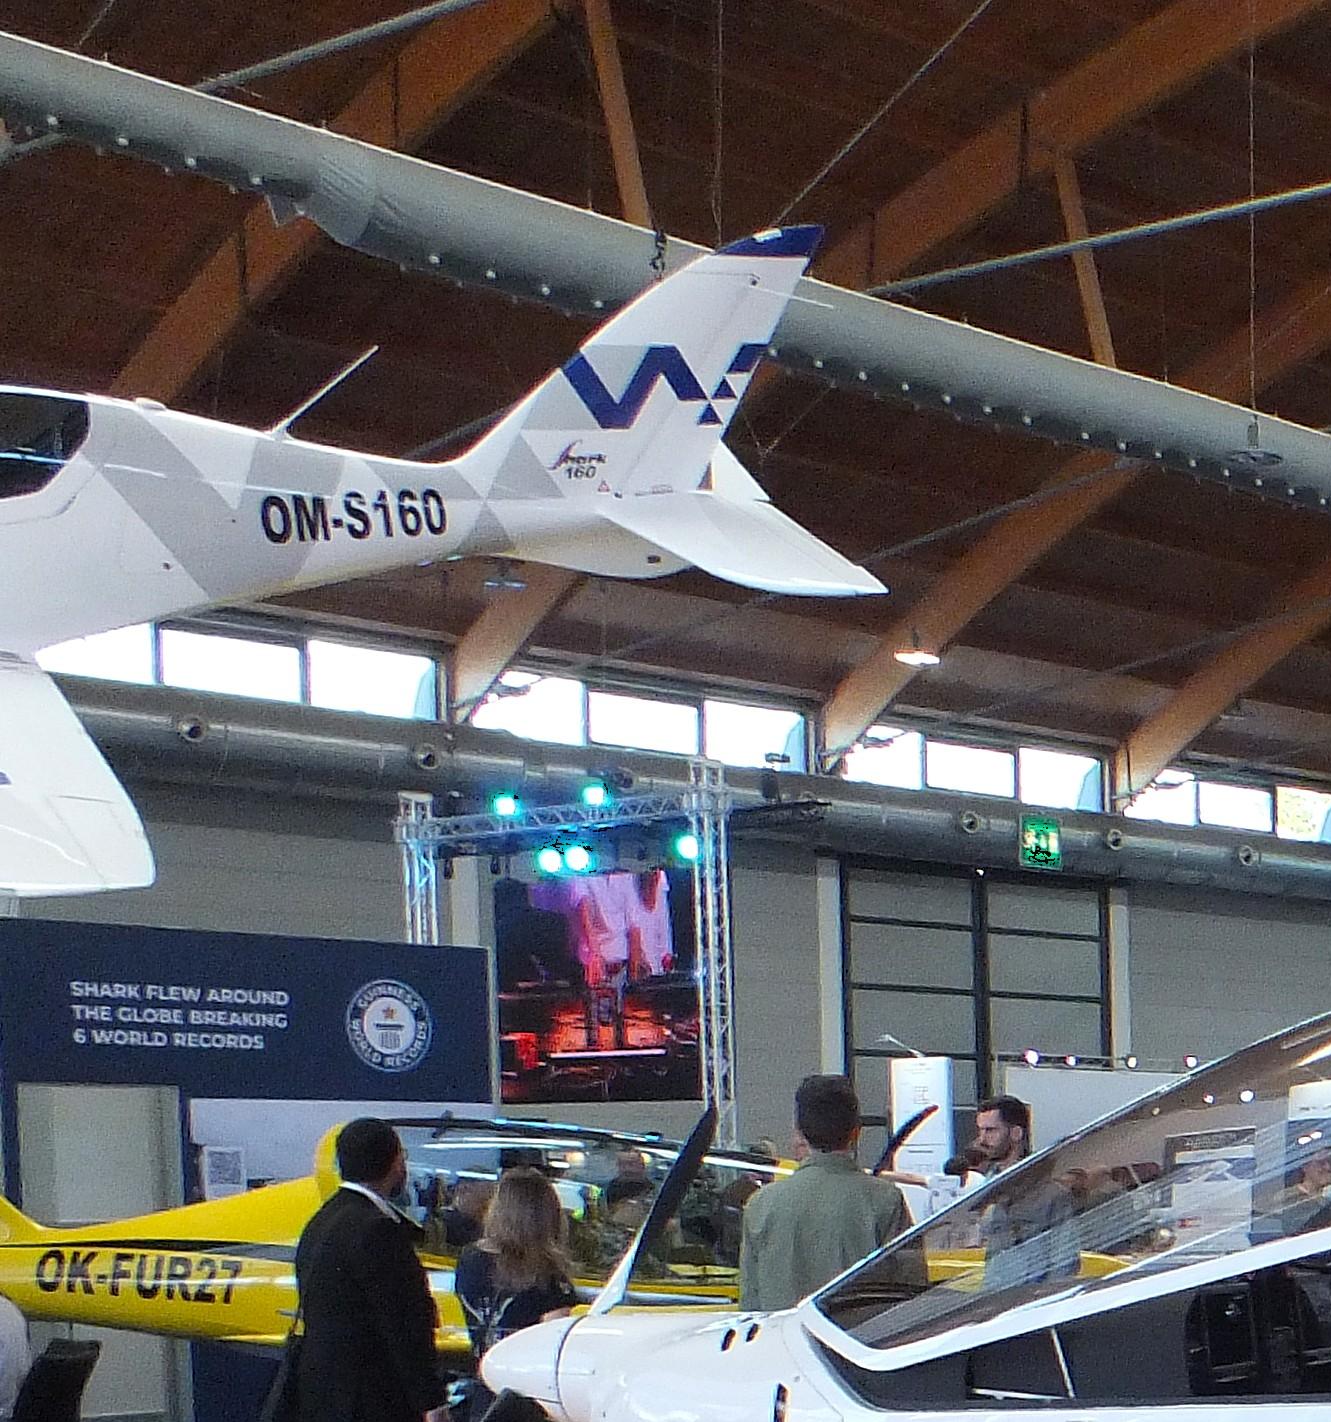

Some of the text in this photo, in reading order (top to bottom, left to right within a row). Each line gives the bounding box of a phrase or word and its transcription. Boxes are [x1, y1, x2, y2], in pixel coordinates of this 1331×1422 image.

[565, 465, 597, 479] 160
[261, 488, 448, 545] OM-S160
[69, 981, 291, 1006] SHARK FLEW AROUND
[69, 1004, 288, 1029] THE GLOBE BREAKING
[73, 1028, 265, 1050] 6 WORLD RECORDS
[36, 1249, 243, 1305] OK-FUR27
